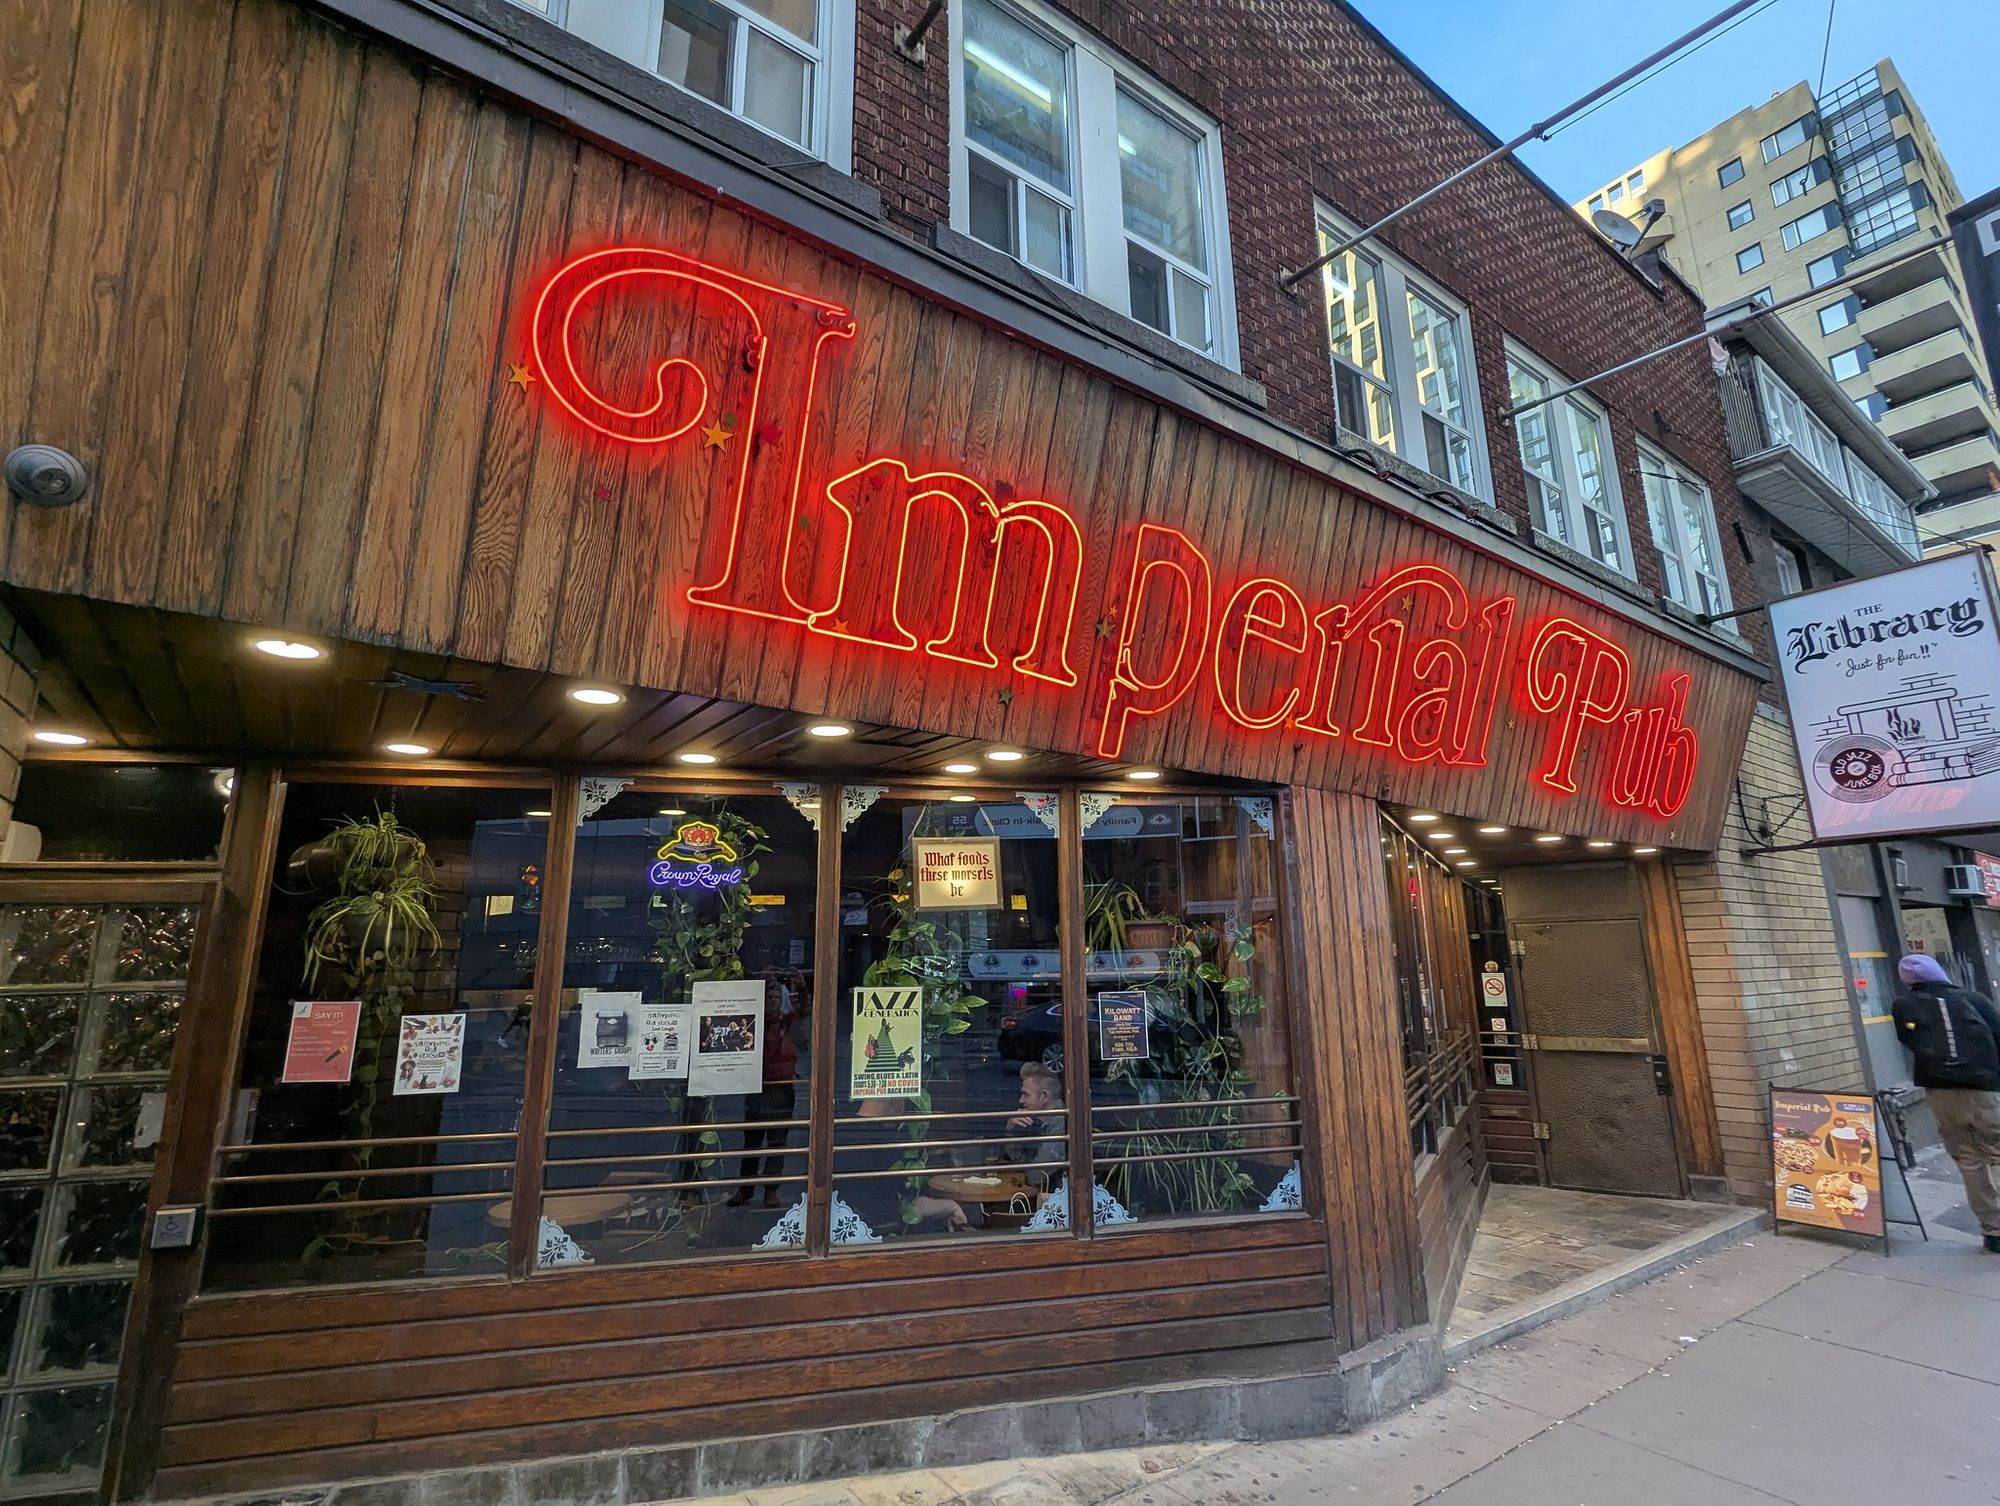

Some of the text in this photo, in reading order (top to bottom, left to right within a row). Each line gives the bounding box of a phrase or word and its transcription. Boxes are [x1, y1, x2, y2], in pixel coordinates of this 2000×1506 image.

[533, 247, 1697, 817] Imperial Pub
[1853, 603, 1883, 617] THE
[1787, 597, 1984, 675] Library
[1876, 653, 1896, 671] for
[1834, 758, 1847, 775] OLD
[1845, 751, 1872, 762] JAZZ
[1843, 777, 1872, 789] JUKE
[1867, 764, 1882, 780] BOX
[924, 851, 990, 867] What foods
[651, 861, 741, 888] Crown Royal
[920, 866, 993, 882] these morsels
[950, 883, 963, 897] be
[857, 991, 919, 1016] JAZZ
[314, 1011, 332, 1020] SAY
[864, 1009, 919, 1018] GENERATION
[854, 1073, 875, 1081] SWING
[876, 1072, 895, 1080] BLUES
[902, 1071, 918, 1079] LATIN
[898, 1079, 918, 1087] COVER
[1775, 1101, 1811, 1113] Imperial
[1813, 1104, 1831, 1113] Pub
